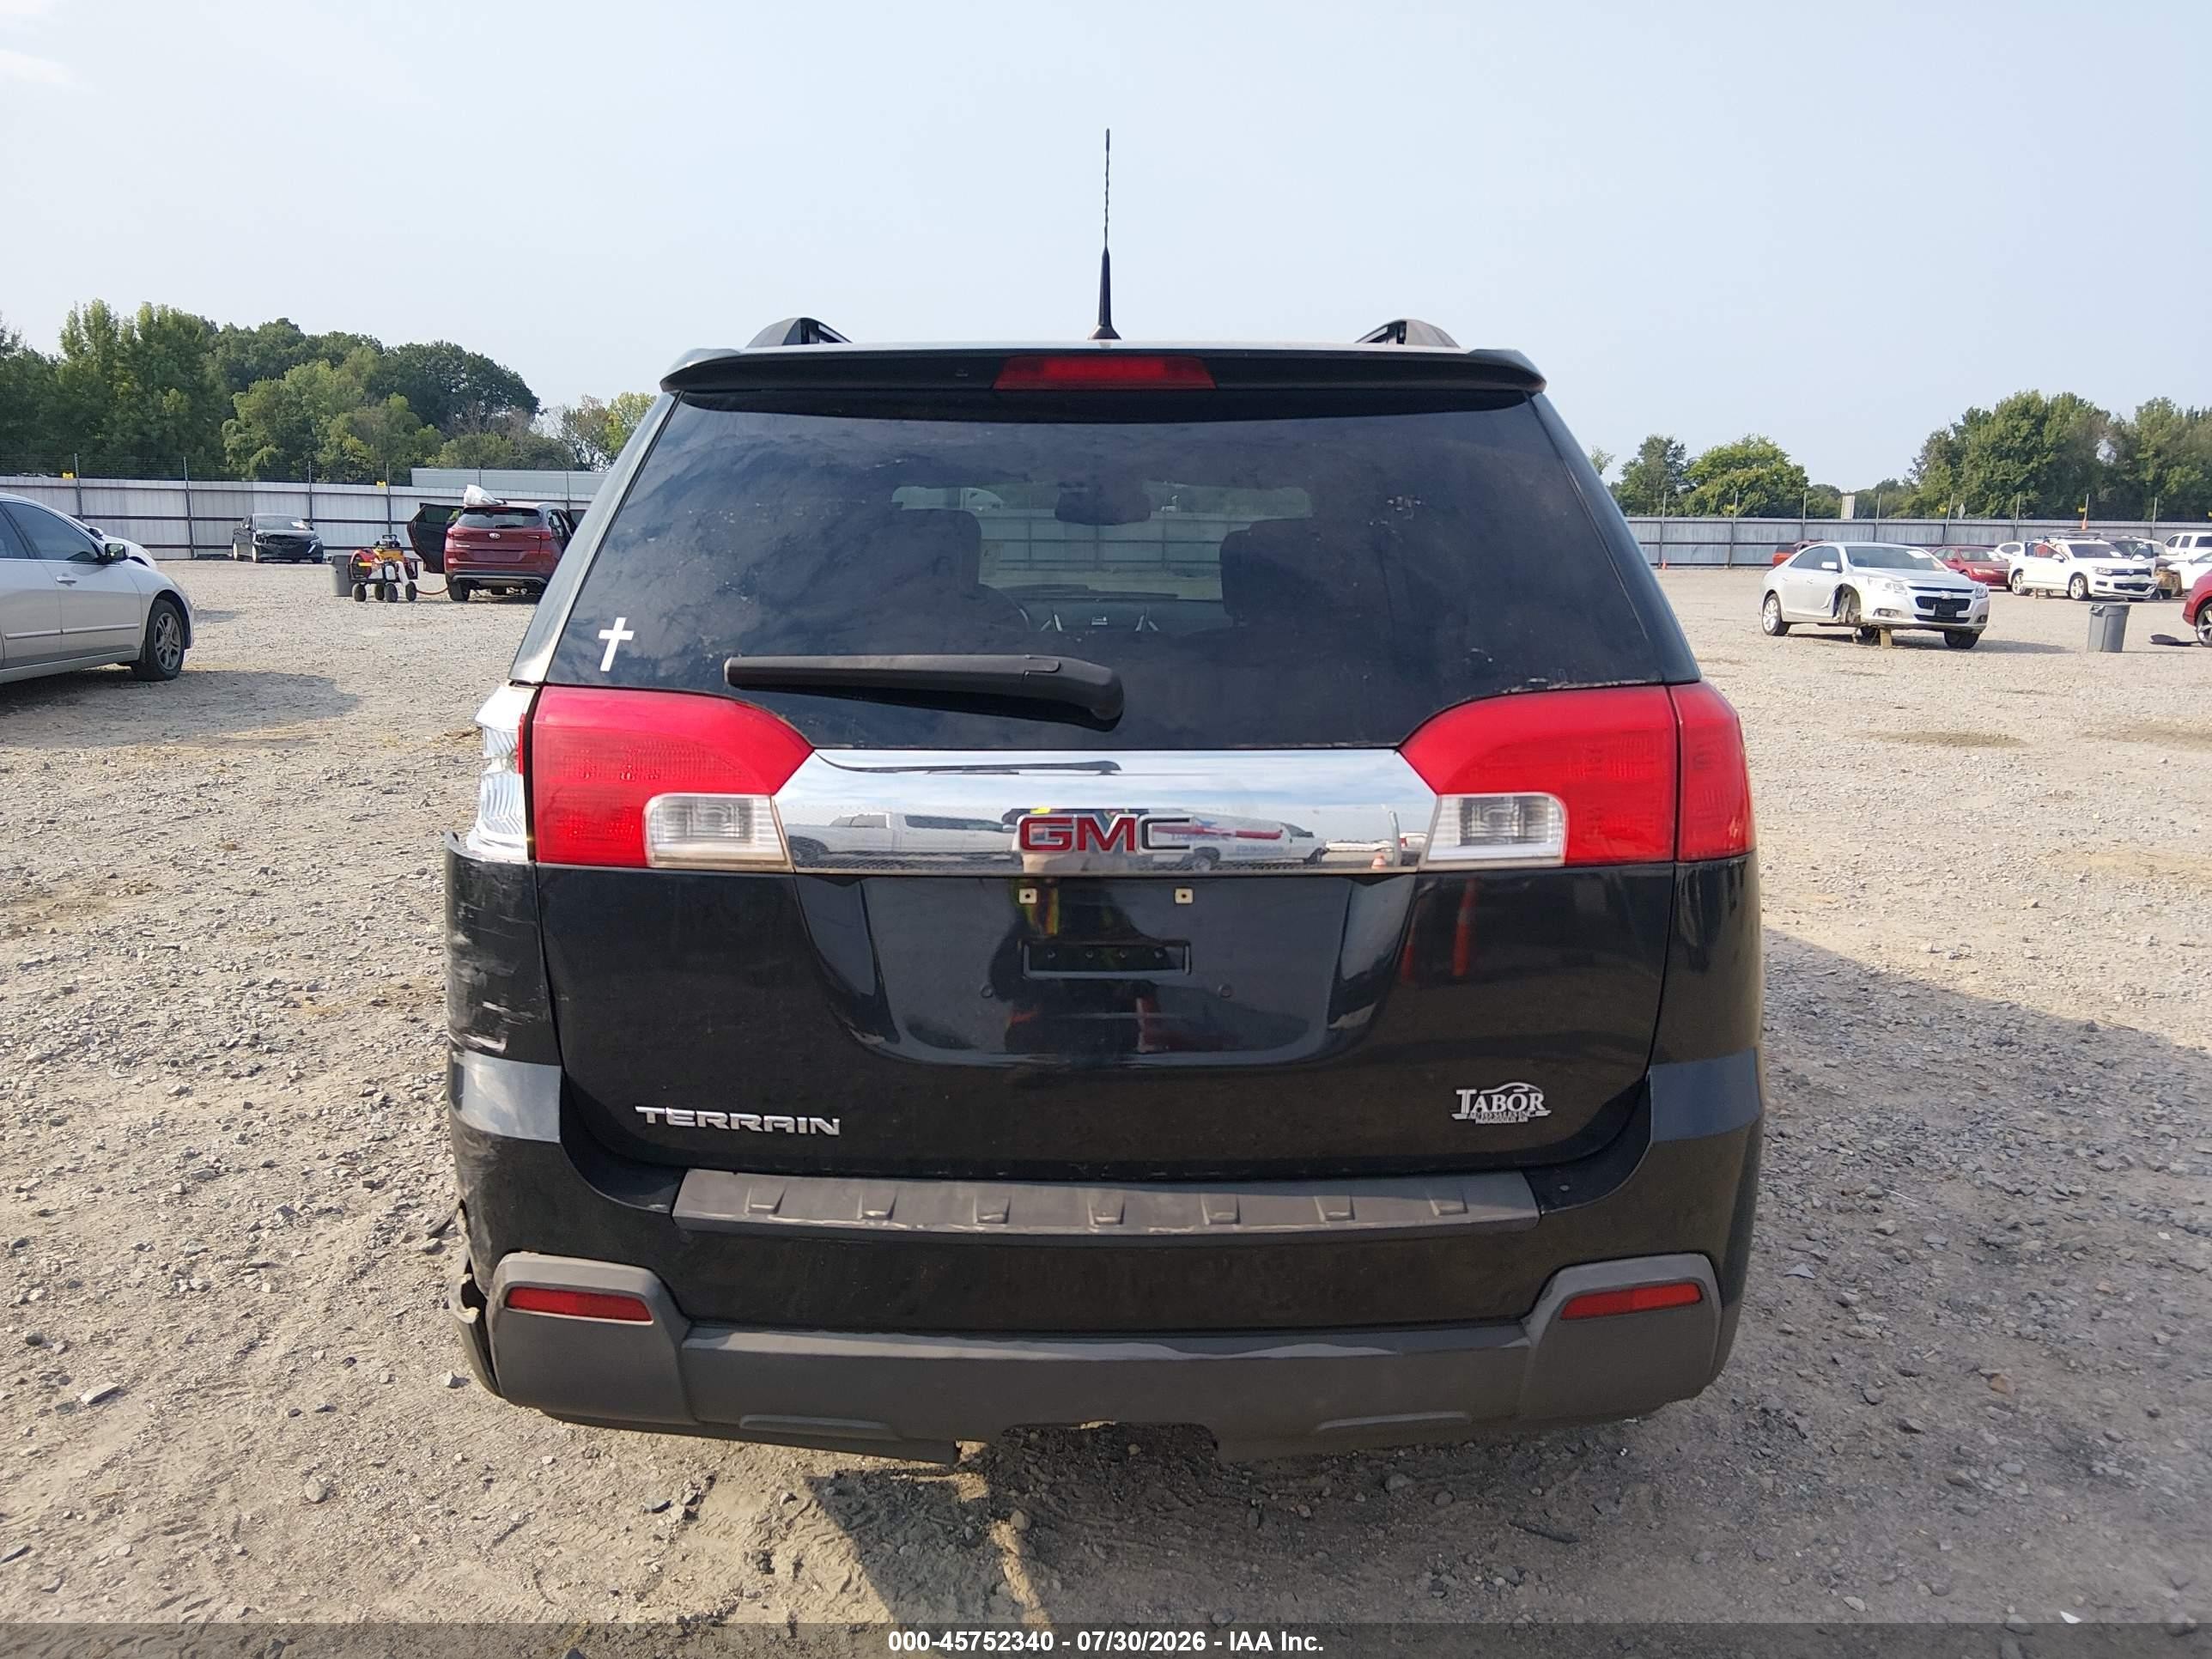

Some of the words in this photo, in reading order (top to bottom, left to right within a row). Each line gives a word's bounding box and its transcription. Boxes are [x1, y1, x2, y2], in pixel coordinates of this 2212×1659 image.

[1017, 814, 1194, 854] GMC
[1454, 1089, 1547, 1117] TABOR
[635, 1105, 841, 1135] TERRAIN
